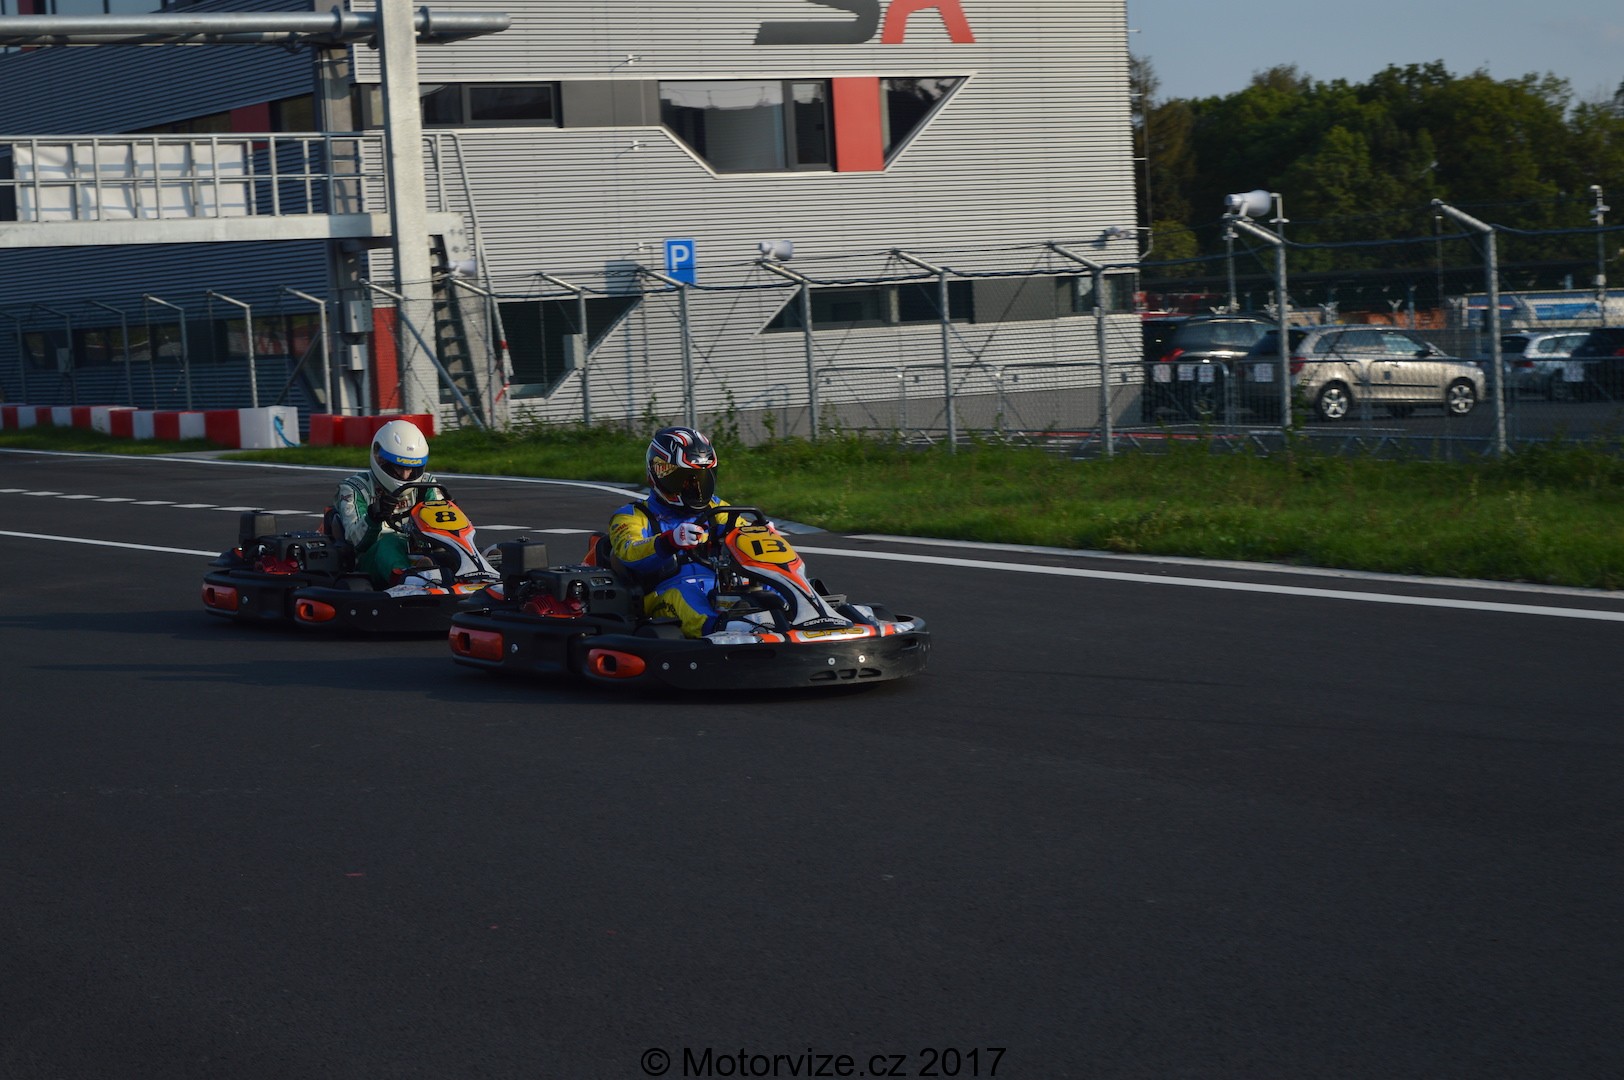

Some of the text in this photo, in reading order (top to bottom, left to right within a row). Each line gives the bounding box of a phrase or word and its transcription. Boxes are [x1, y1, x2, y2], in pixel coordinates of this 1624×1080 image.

[671, 244, 690, 273] P
[396, 457, 422, 465] VEGA
[435, 510, 457, 522] 8
[751, 538, 787, 556] 13
